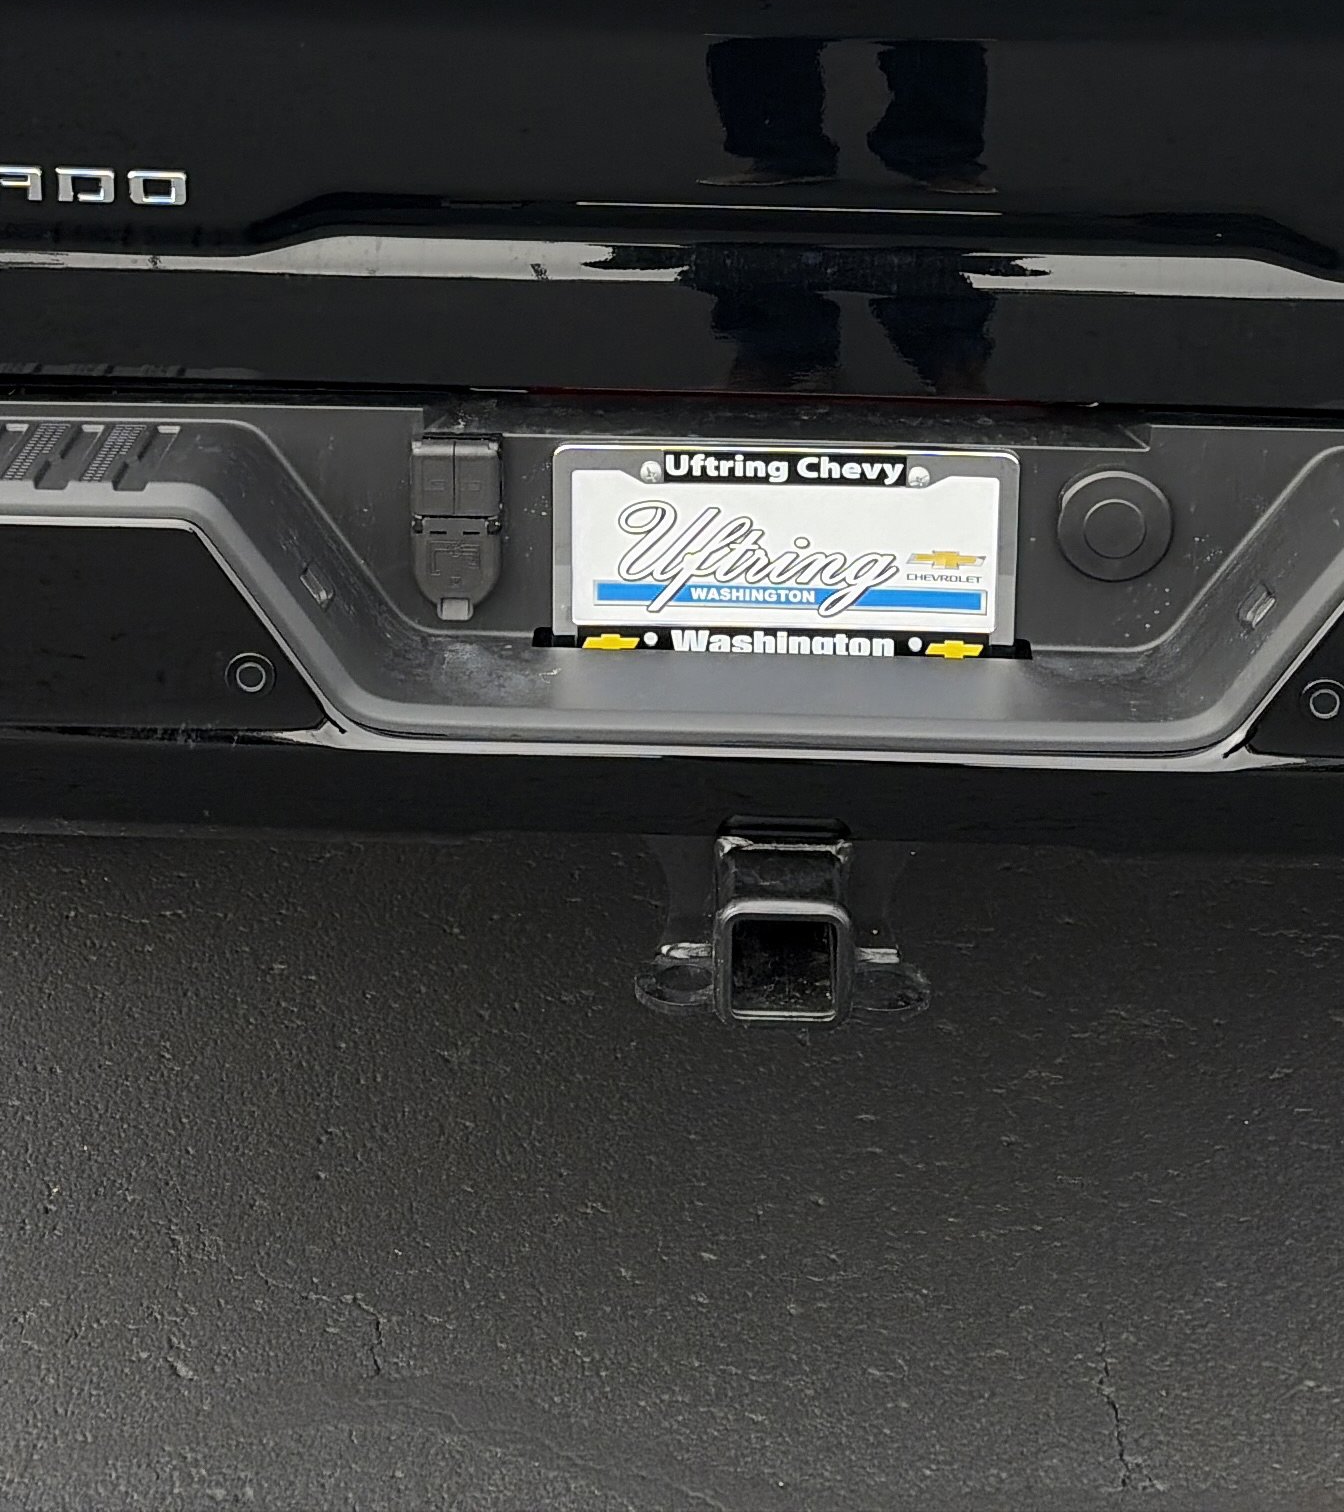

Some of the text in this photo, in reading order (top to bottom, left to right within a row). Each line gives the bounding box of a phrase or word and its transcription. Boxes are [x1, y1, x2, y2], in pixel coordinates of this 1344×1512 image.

[665, 453, 904, 486] Uftring Chevy
[617, 499, 900, 617] Uftring
[906, 573, 983, 584] CHEVROLET
[690, 586, 816, 604] WASHINGTON
[670, 629, 895, 657] Washington
